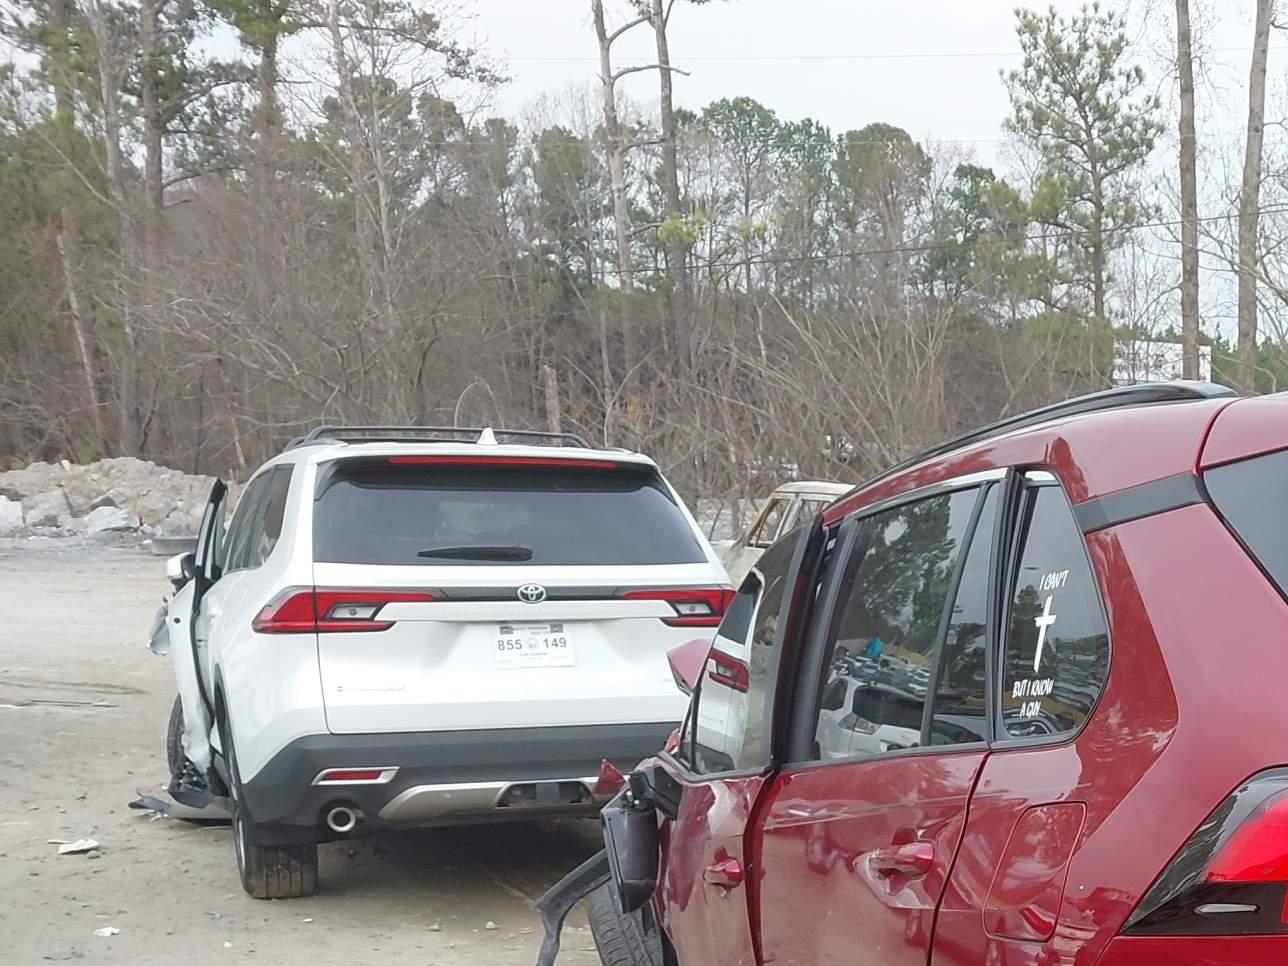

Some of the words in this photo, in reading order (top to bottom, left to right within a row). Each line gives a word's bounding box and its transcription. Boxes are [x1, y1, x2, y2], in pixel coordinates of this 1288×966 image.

[497, 639, 523, 651] 855
[543, 637, 567, 648] 149
[1012, 679, 1028, 699] BUT
[1026, 680, 1031, 696] I
[1030, 678, 1055, 696] KNOW
[1026, 700, 1042, 719] GUY
